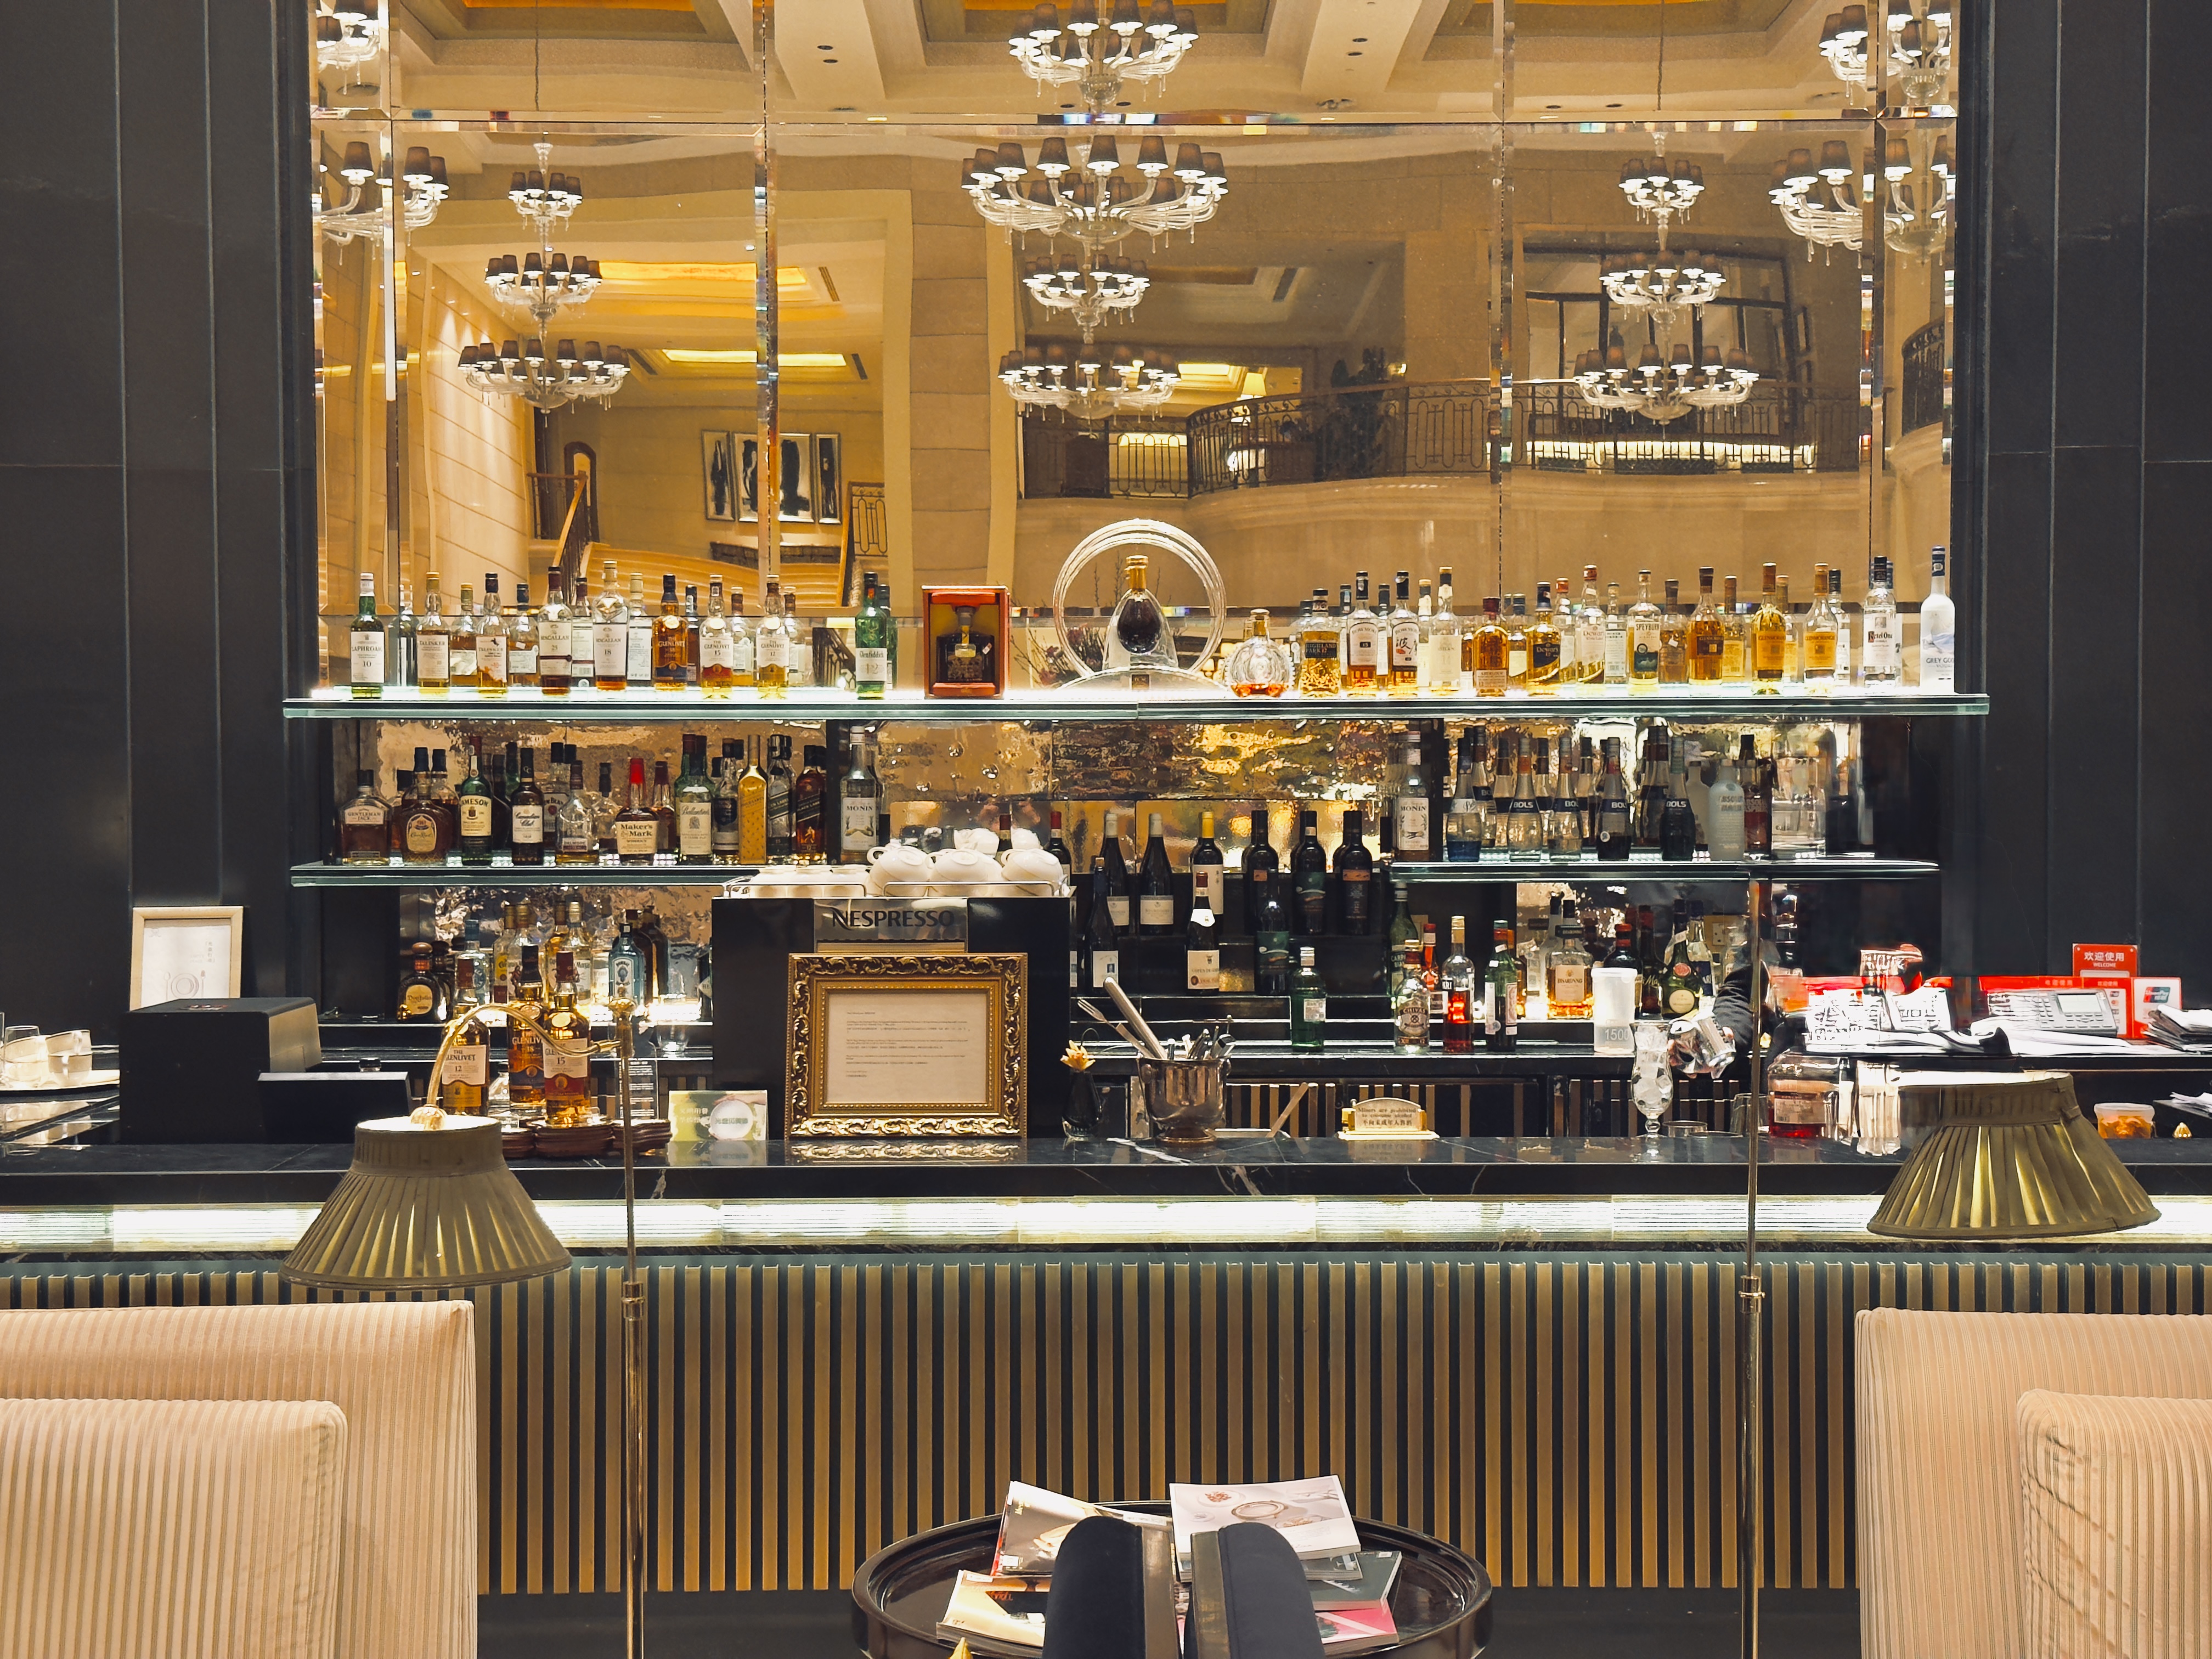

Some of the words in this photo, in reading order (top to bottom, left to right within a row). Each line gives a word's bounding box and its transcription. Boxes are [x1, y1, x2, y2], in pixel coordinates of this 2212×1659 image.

[825, 907, 955, 930] NESPRESSO
[2084, 951, 2125, 962] 欢迎使用
[1605, 1029, 1629, 1041] 1500
[512, 1037, 543, 1045] GLENLIV
